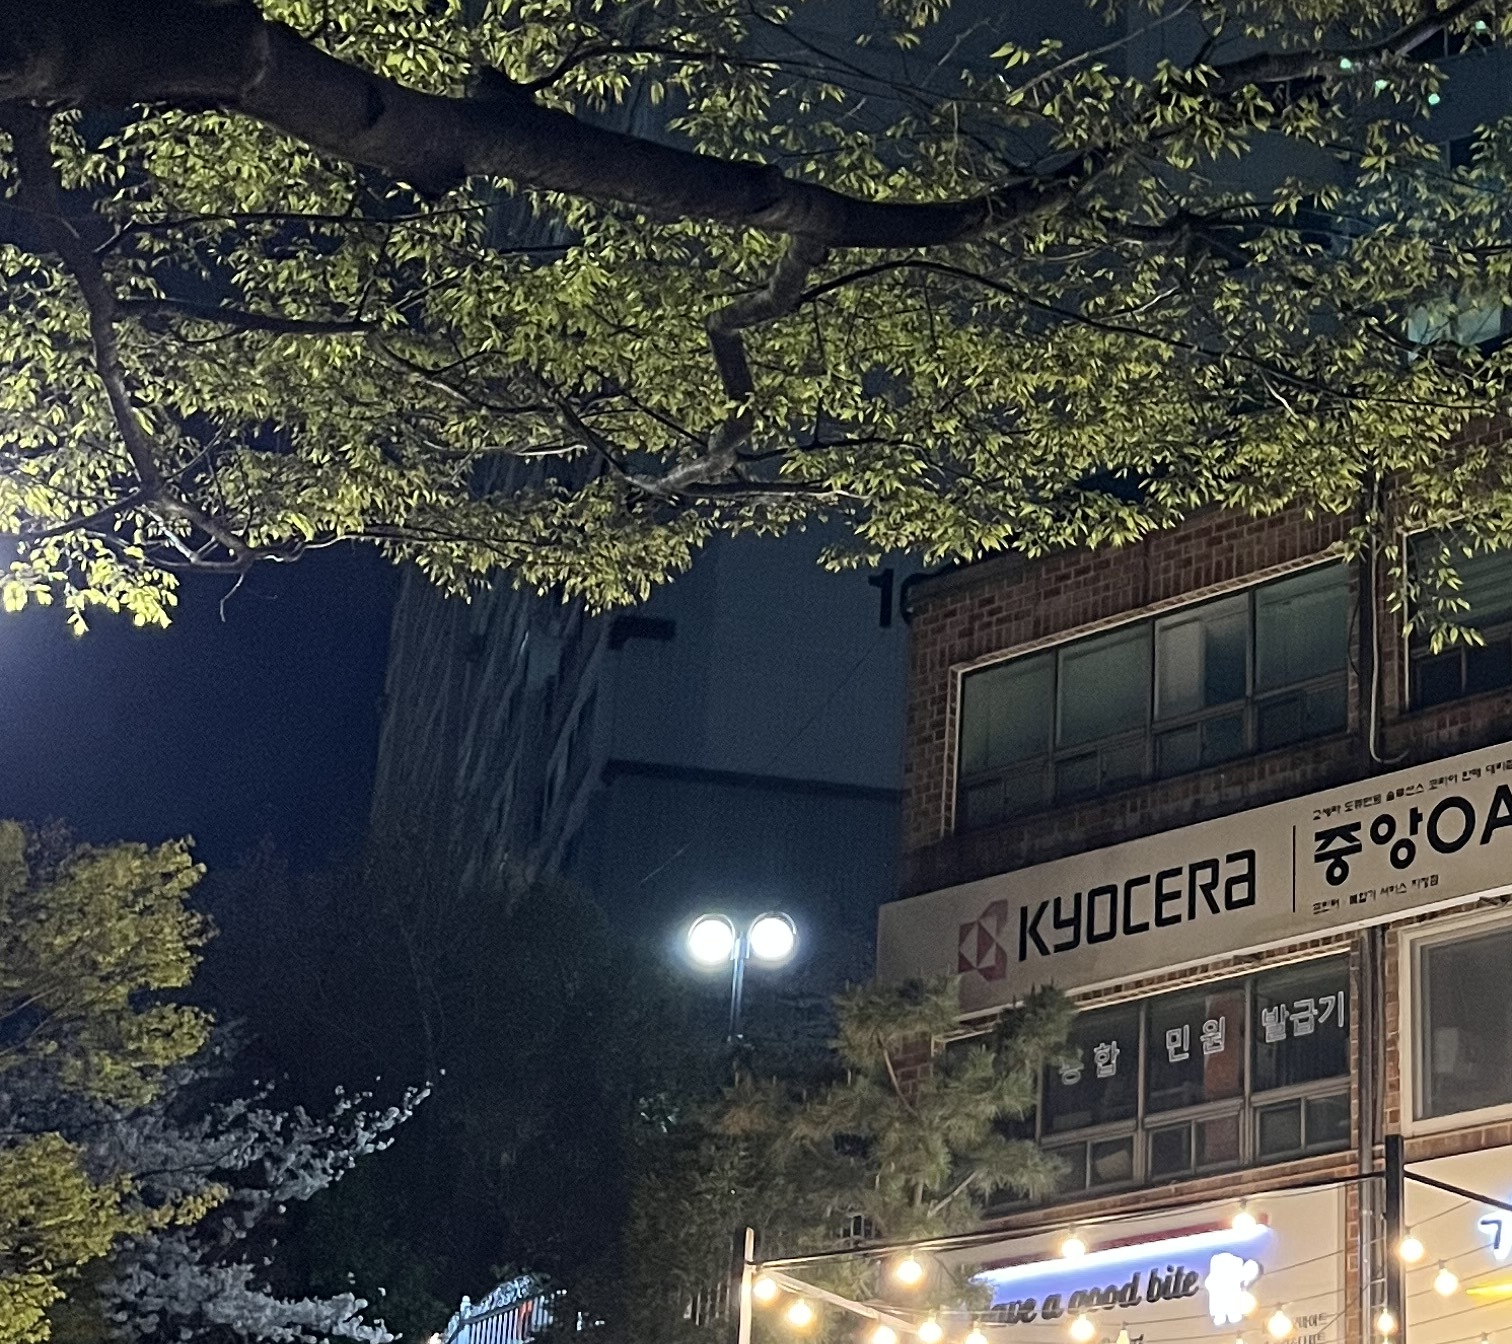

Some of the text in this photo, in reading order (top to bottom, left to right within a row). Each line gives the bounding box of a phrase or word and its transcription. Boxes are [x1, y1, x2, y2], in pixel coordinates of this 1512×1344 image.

[1018, 848, 1257, 962] KYOCERA
[1260, 990, 1345, 1044] 발급기
[1042, 1293, 1064, 1320] a
[1146, 1264, 1200, 1303] bite
